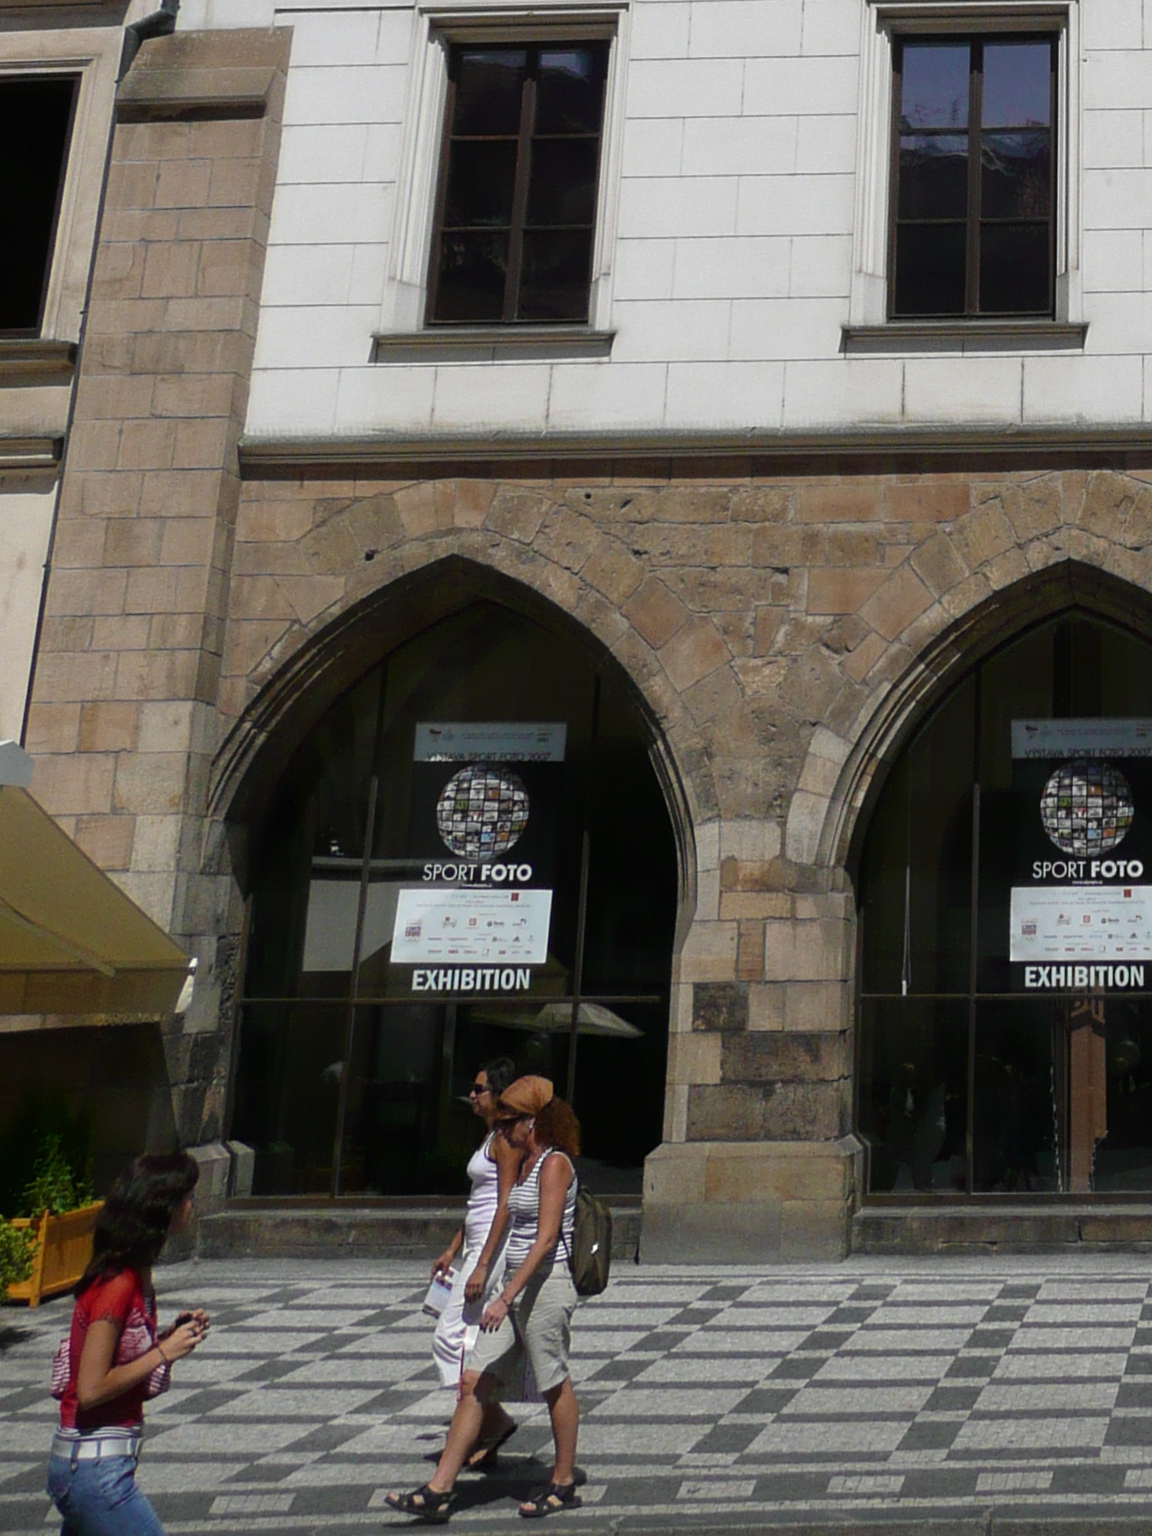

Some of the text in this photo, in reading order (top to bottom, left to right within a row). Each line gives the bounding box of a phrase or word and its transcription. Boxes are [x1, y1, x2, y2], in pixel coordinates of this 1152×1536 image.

[422, 864, 532, 882] SPORT FOTO
[1032, 860, 1144, 879] SPORT FOTO
[412, 968, 531, 990] EXHIBITION
[1024, 965, 1145, 987] EXHIBITION
